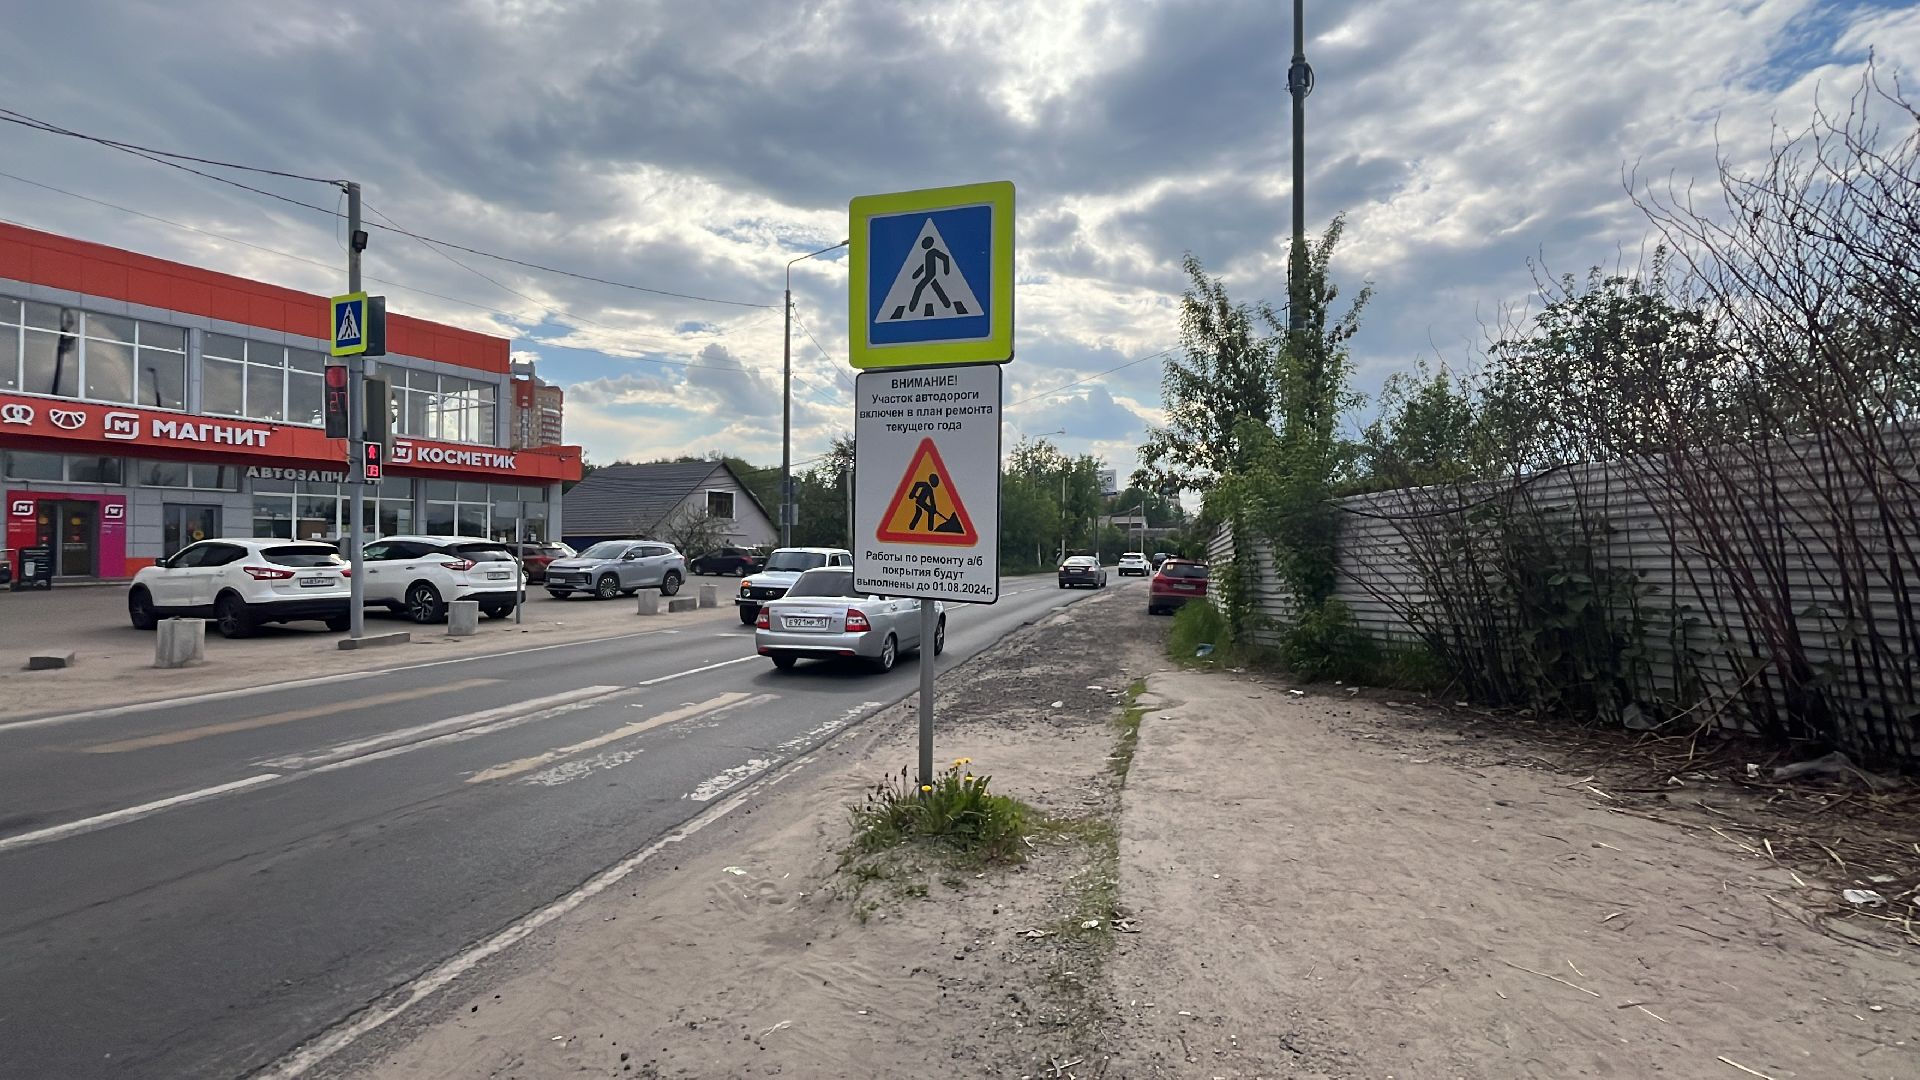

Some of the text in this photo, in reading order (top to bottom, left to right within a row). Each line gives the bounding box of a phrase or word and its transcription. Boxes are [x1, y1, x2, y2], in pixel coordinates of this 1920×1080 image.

[891, 375, 958, 389] ВНИМАНИЕ!
[872, 391, 979, 404] Участок автодороги
[860, 405, 993, 419] включен в план ремонта
[152, 419, 271, 447] МАГНИТ
[886, 421, 962, 433] текущего года
[417, 446, 516, 470] КОСМЕТИК
[246, 465, 384, 485] АВТОЗАПЧ
[866, 551, 983, 567] Работы по ремонту а/б
[882, 566, 964, 580] покрытия будут
[857, 578, 993, 595] выполнены до 01.08.2024г.
